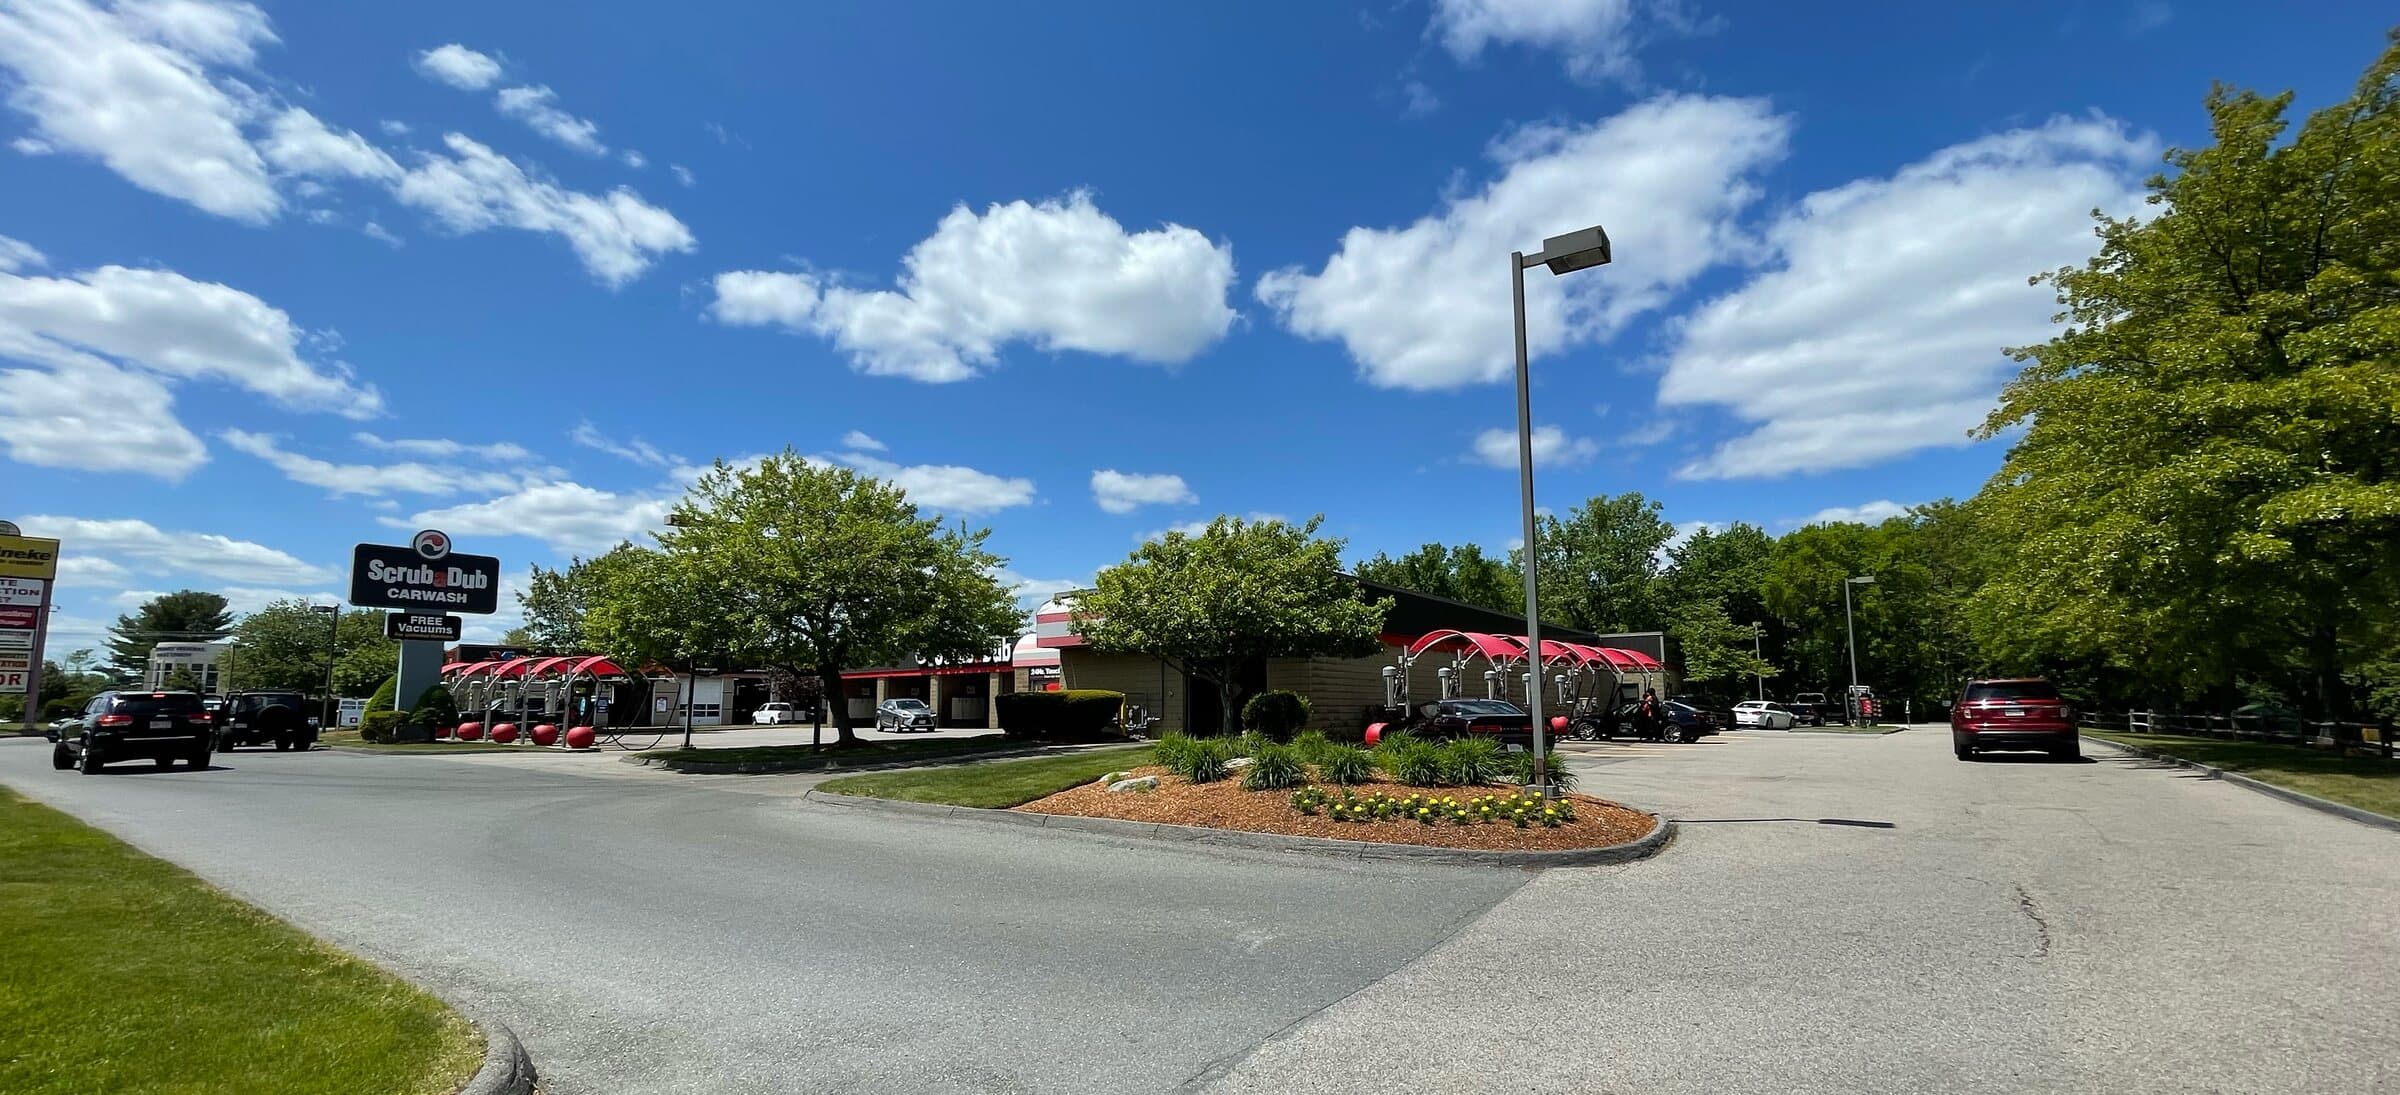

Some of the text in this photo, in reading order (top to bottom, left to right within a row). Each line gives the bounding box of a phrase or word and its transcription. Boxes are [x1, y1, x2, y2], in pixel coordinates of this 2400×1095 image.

[387, 588, 468, 603] CARWASH
[410, 615, 443, 626] FREE
[398, 622, 453, 635] Vacuums
